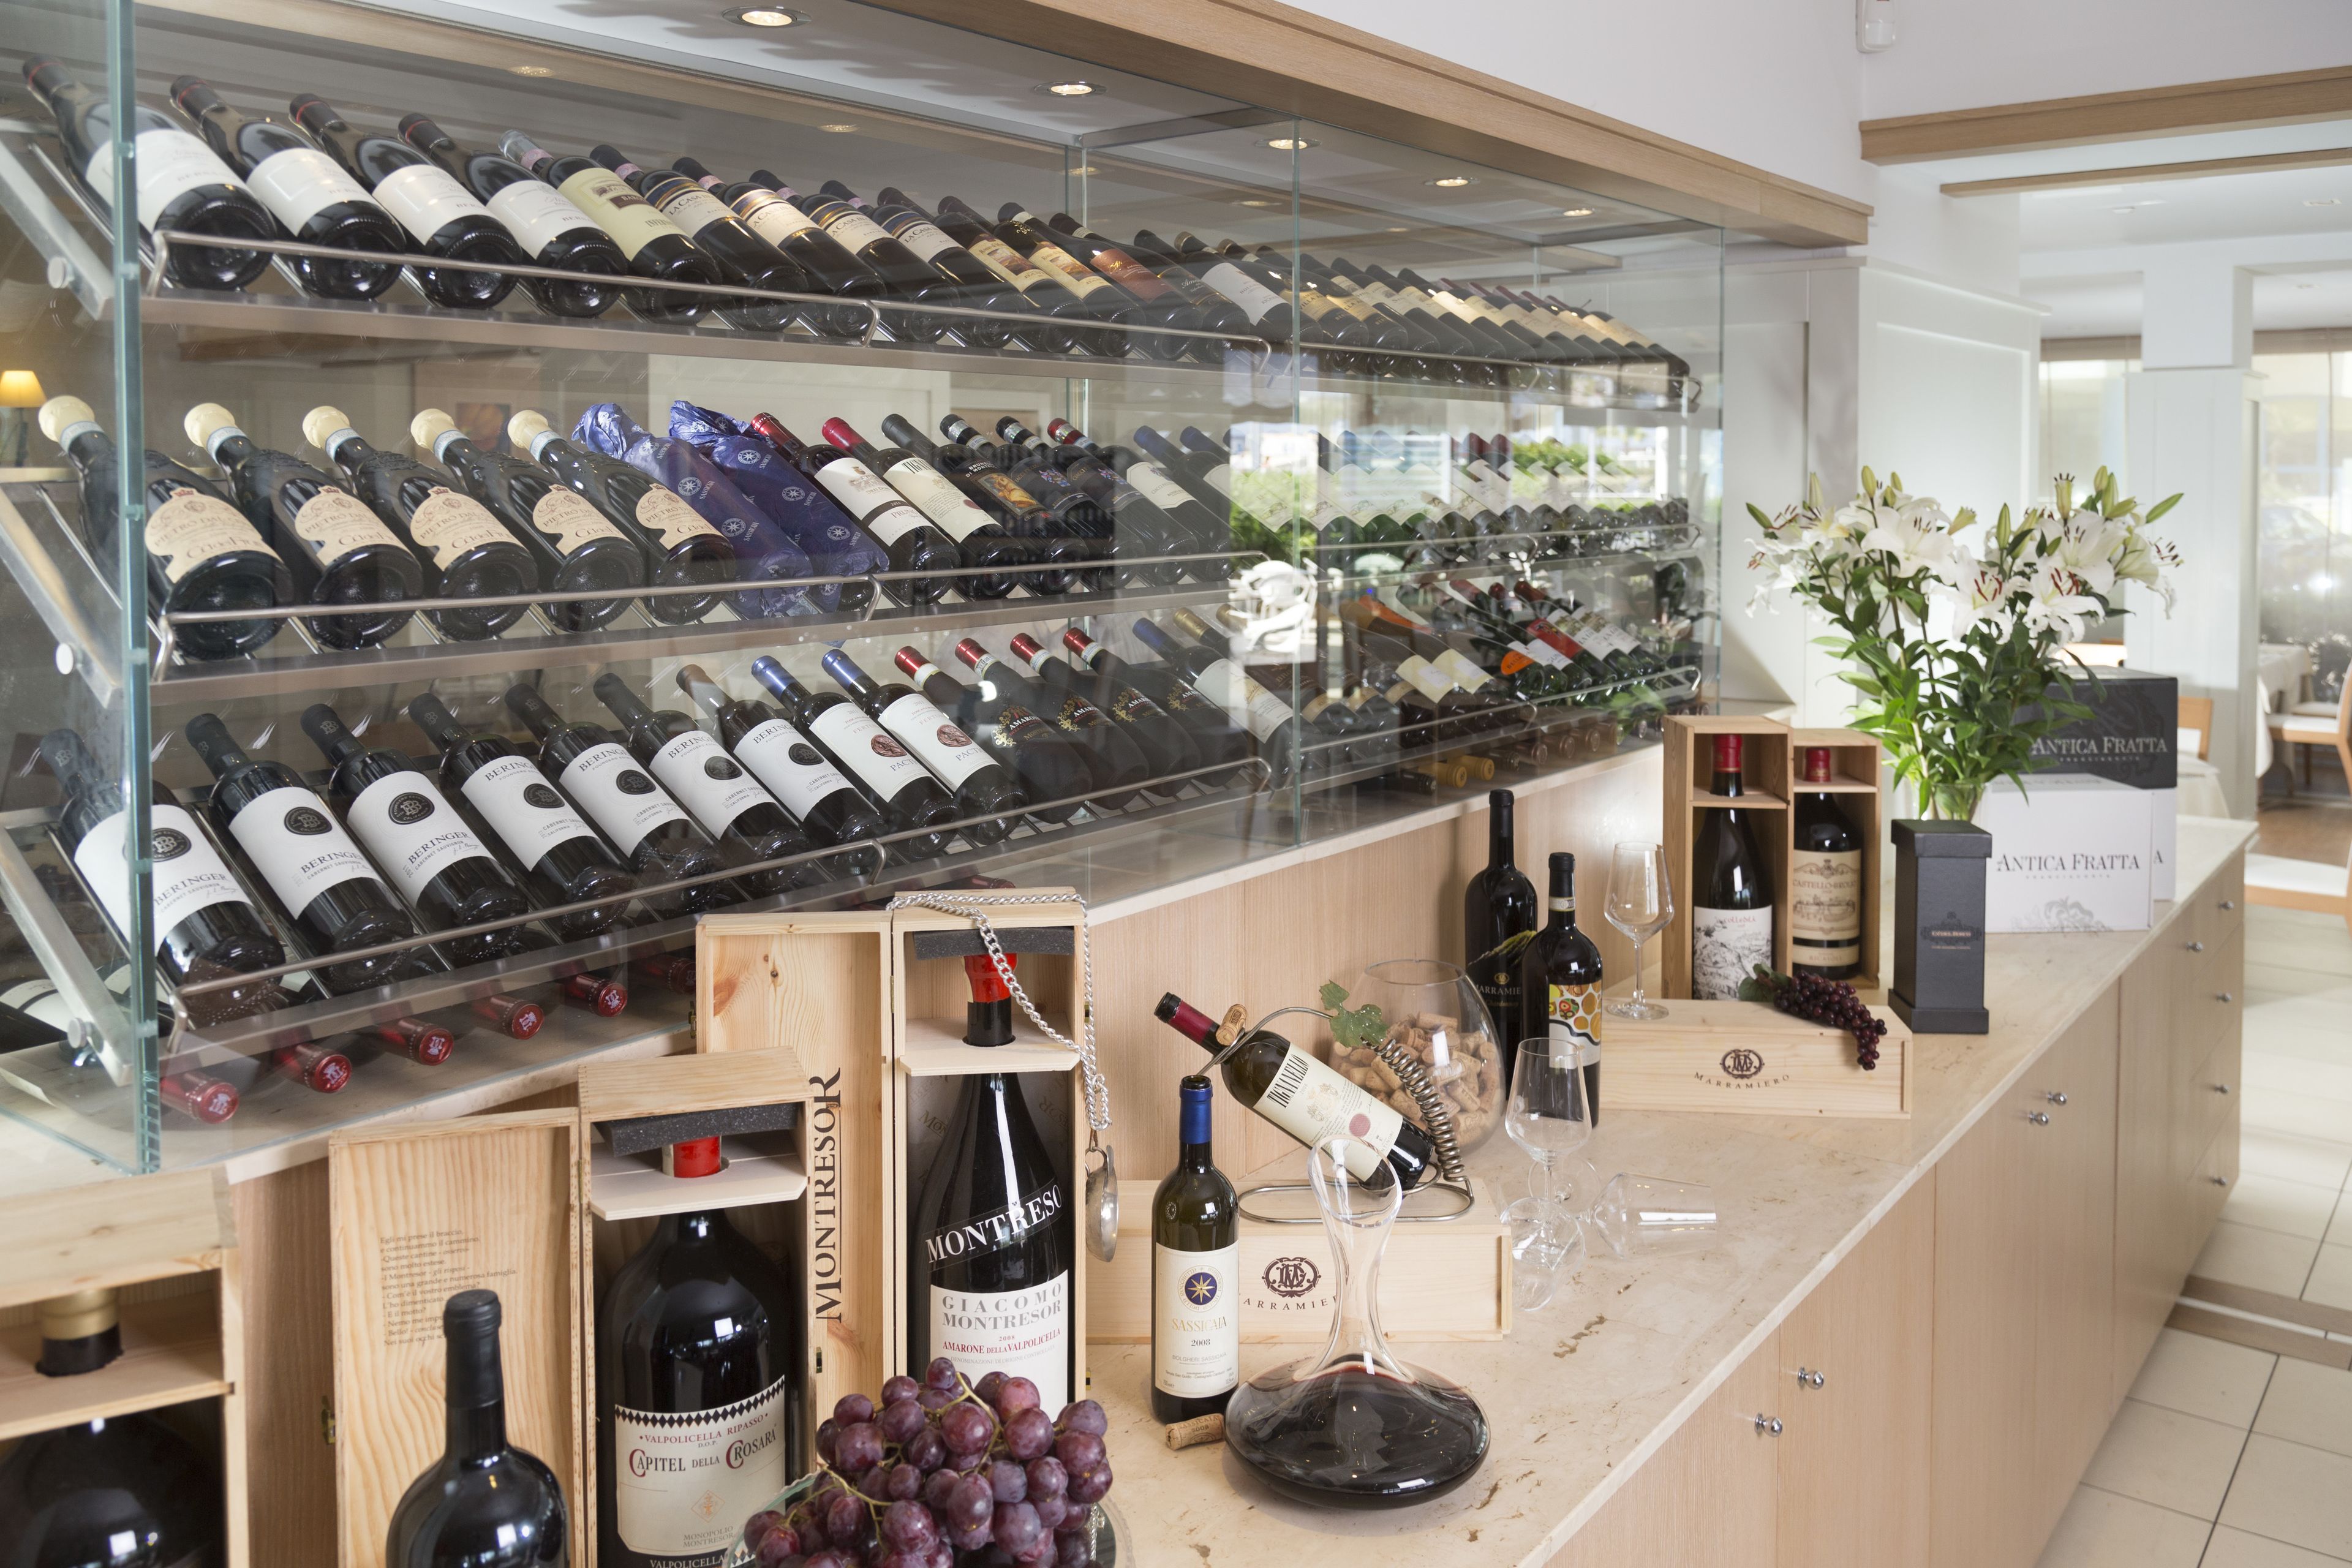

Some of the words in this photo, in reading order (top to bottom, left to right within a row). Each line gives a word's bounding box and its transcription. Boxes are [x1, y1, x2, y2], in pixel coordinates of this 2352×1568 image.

[679, 195, 701, 206] CASA
[543, 508, 579, 527] PIETRO
[646, 507, 678, 522] PIETRO
[2031, 736, 2098, 755] ANTICA
[2102, 736, 2168, 755] FRATTA
[408, 831, 470, 864] BERINGER
[415, 851, 436, 870] CABERNET
[1997, 854, 2066, 872] ANTICA
[2071, 853, 2141, 871] FRATTA
[307, 864, 333, 880] CABERNET
[154, 873, 228, 907] BERINGER
[1267, 1054, 1310, 1108] TIGNANELLO
[1694, 1071, 1790, 1089] MARRAMIERO
[809, 1068, 842, 1323] MONTRESOR
[925, 1185, 1063, 1264] MONTRESO
[408, 1234, 428, 1242] prese
[386, 1241, 437, 1253] continuammo
[389, 1270, 427, 1280] Montresor
[417, 1278, 442, 1287] grande
[450, 1273, 485, 1283] numerosa
[443, 1281, 480, 1292] emblema?
[941, 1283, 1061, 1313] GIACOMO
[1242, 1294, 1336, 1311] ARRAMIE
[401, 1307, 426, 1316] motto?
[941, 1299, 1061, 1330] MONTRESOR
[1172, 1316, 1227, 1332] SASSICAIA
[943, 1341, 985, 1354] AMARONE
[987, 1346, 1008, 1354] DELLA
[1008, 1327, 1061, 1352] VALPOLICELLA
[1191, 1338, 1210, 1347] 2008
[1201, 1352, 1227, 1362] SASSICAIA
[644, 1431, 722, 1444] VALPOLICELLA
[727, 1415, 764, 1435] RIPASSO
[629, 1449, 686, 1477] CAPITEL
[692, 1456, 720, 1468] DELLA
[682, 1532, 734, 1548] MONTRESOR
[683, 1526, 734, 1541] MONOPOLIO
[650, 1555, 725, 1568] VALPOLICELLA
